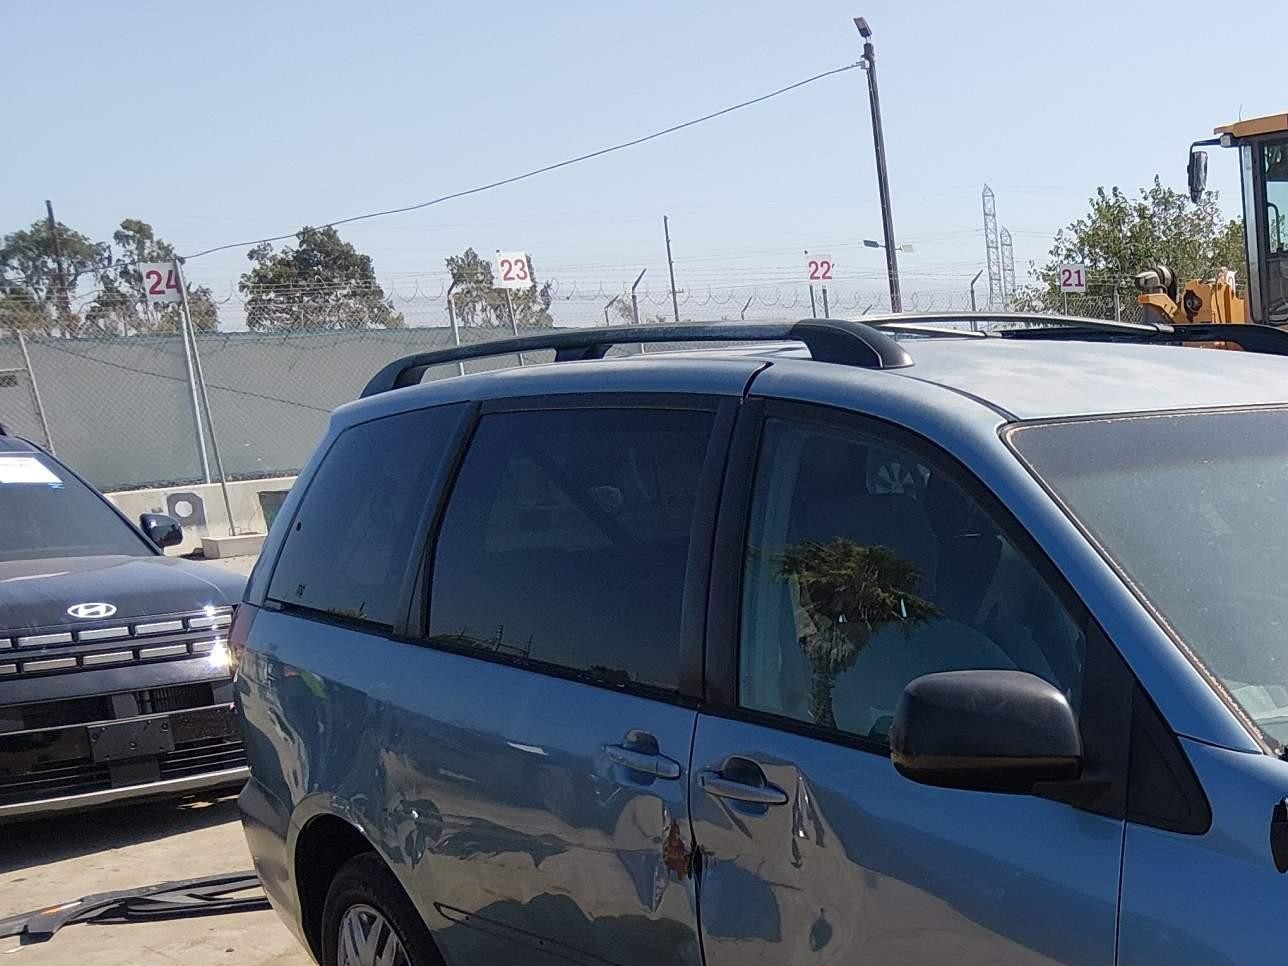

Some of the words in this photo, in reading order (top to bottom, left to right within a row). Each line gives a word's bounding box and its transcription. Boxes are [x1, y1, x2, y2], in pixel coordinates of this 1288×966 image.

[500, 259, 528, 281] 23
[808, 260, 833, 280] 22
[1062, 269, 1085, 287] 21
[146, 269, 180, 295] 24
